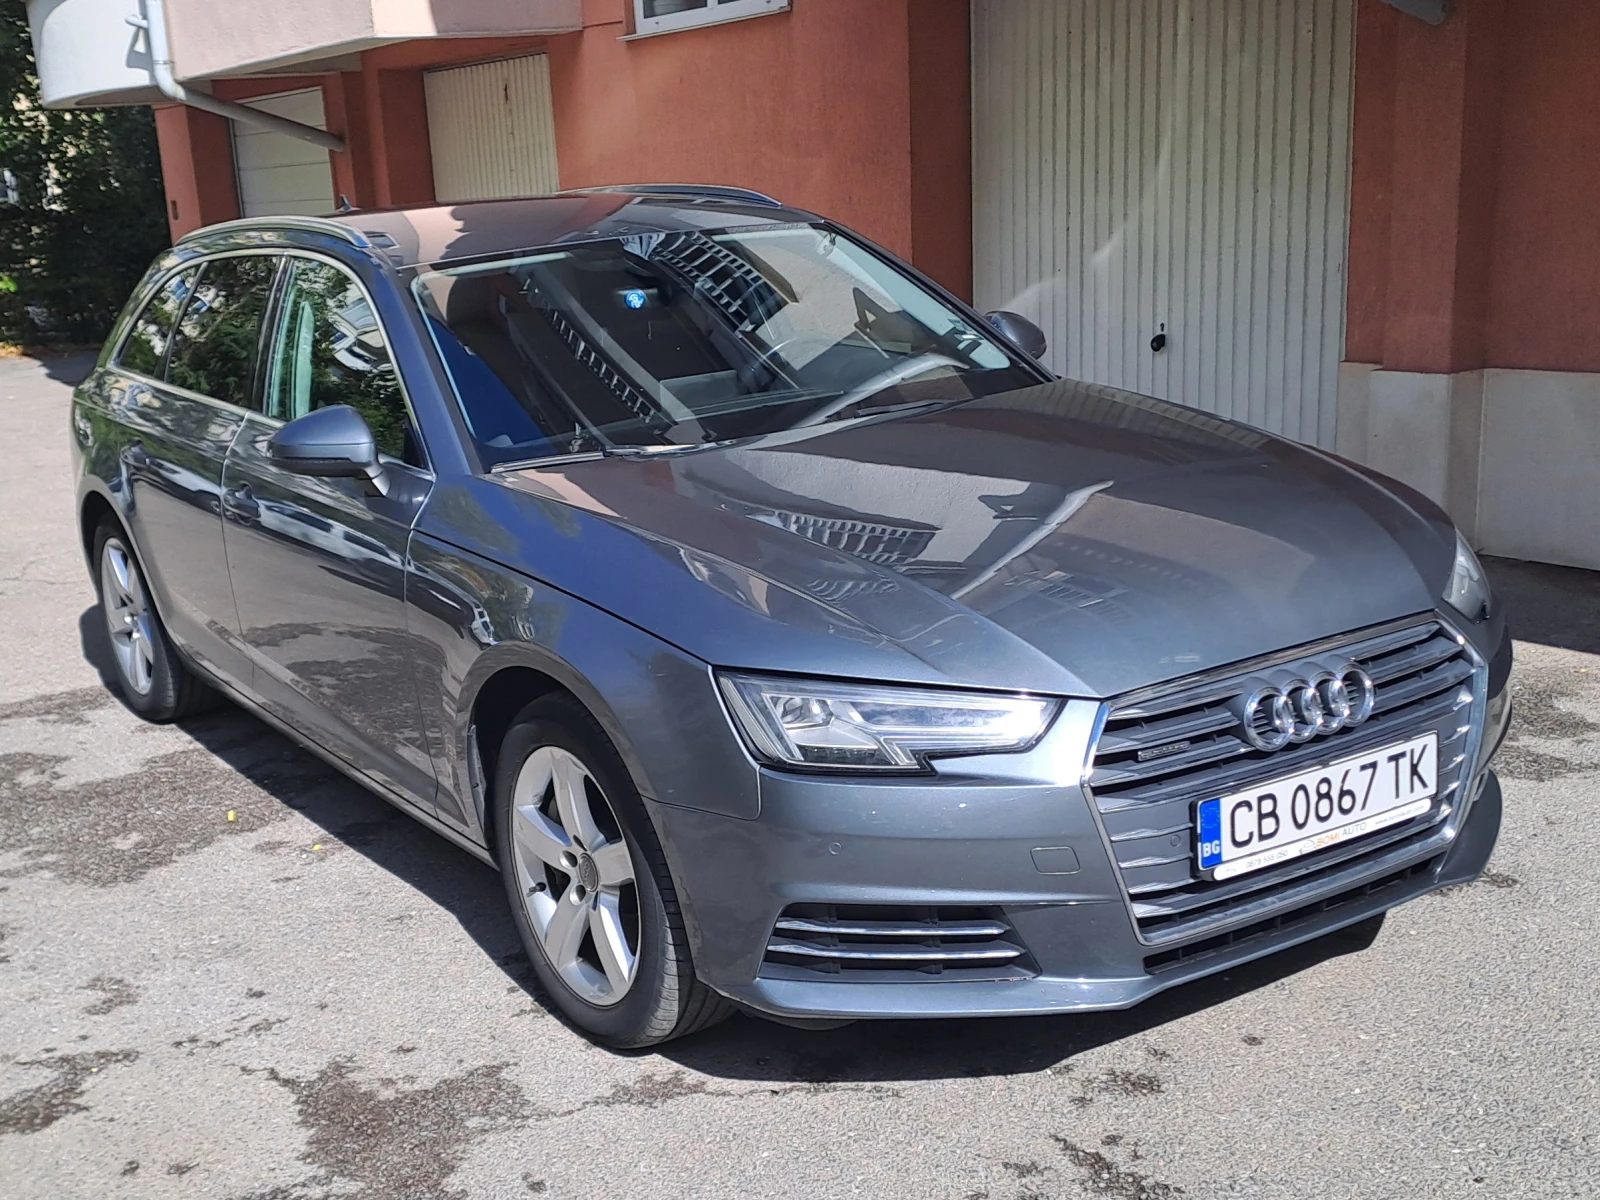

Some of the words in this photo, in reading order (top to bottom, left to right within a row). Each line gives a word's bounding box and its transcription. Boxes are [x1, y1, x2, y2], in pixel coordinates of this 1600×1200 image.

[1230, 793, 1280, 849] CB
[1291, 760, 1378, 830] 0867
[1387, 744, 1428, 799] TK
[1316, 832, 1340, 847] BOMI
[1342, 822, 1367, 836] AUTO
[1203, 841, 1220, 857] BG
